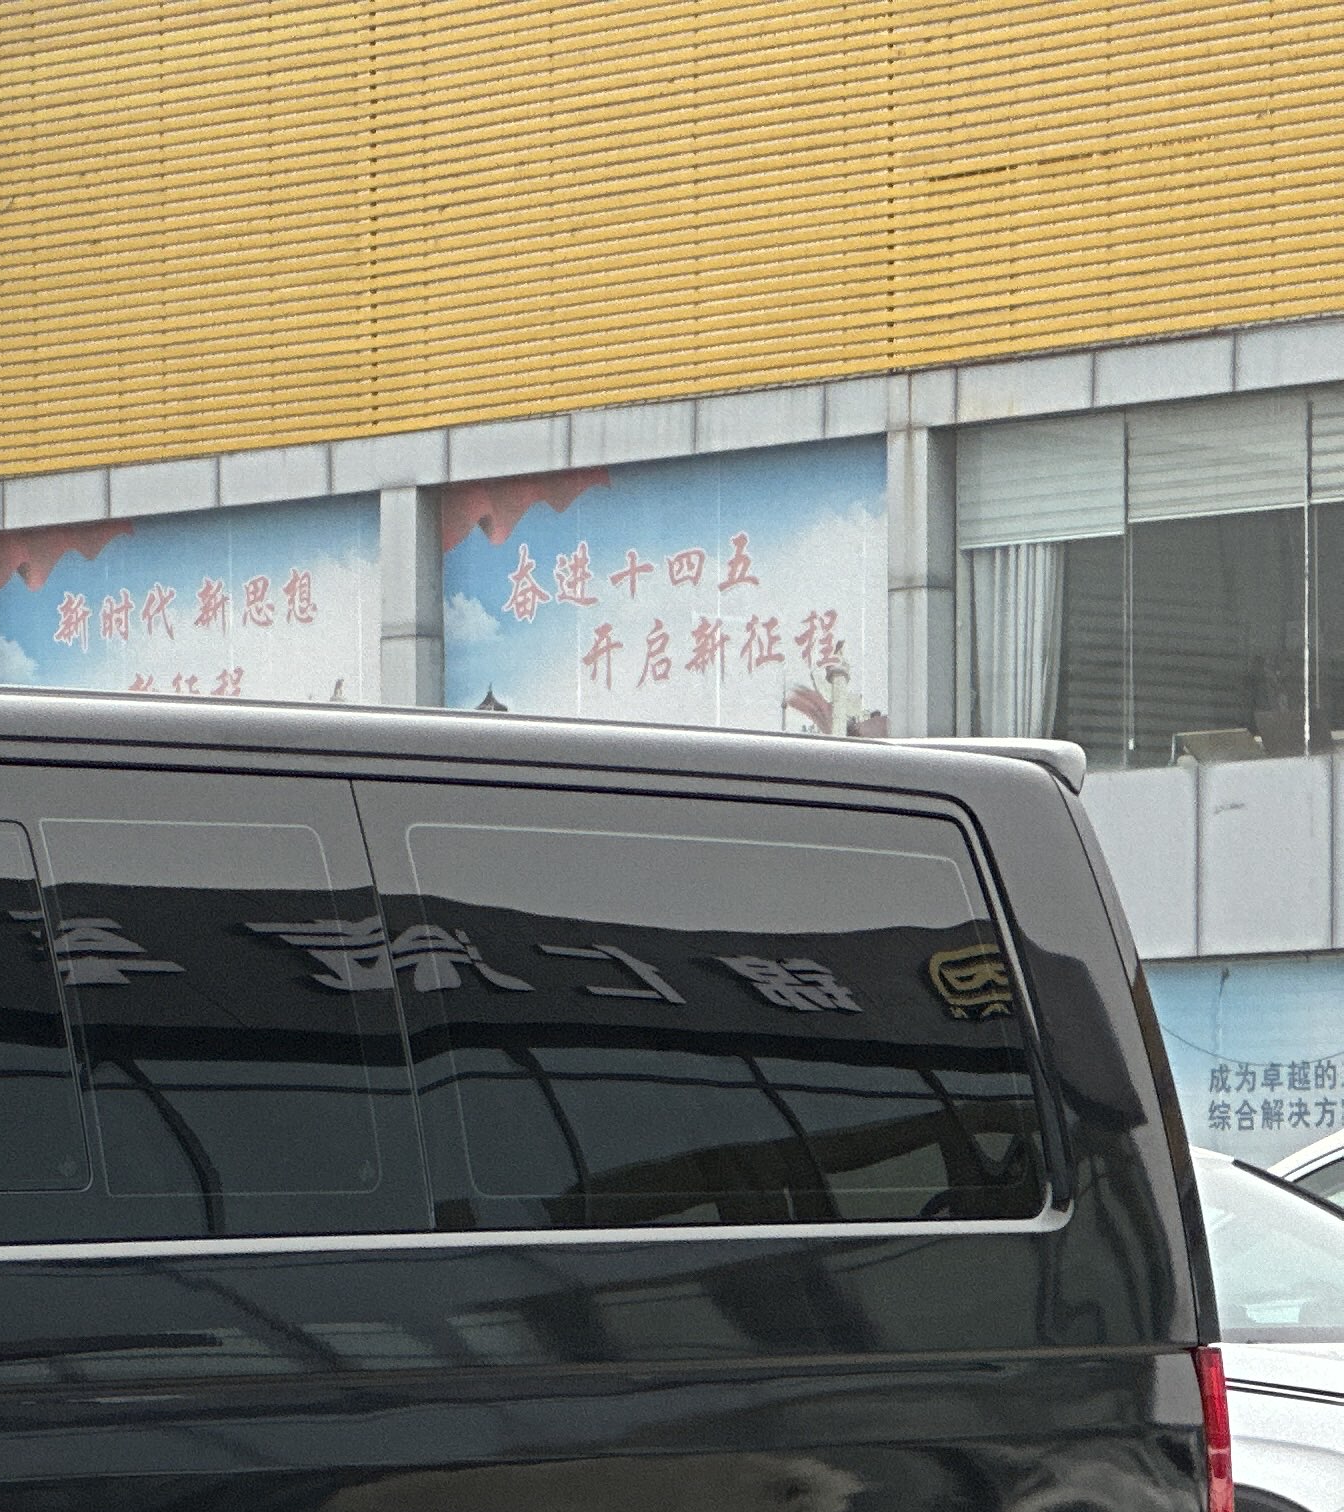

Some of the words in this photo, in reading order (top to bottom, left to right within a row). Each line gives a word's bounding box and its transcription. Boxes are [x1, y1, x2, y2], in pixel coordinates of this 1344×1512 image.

[54, 582, 176, 653] 新时代
[194, 567, 318, 637] 新思想
[502, 531, 760, 623] 奋进十四五
[582, 608, 842, 690] 开启新征程
[1208, 1096, 1344, 1131] 综合解决方
[1209, 1059, 1344, 1093] 成为卓越的
